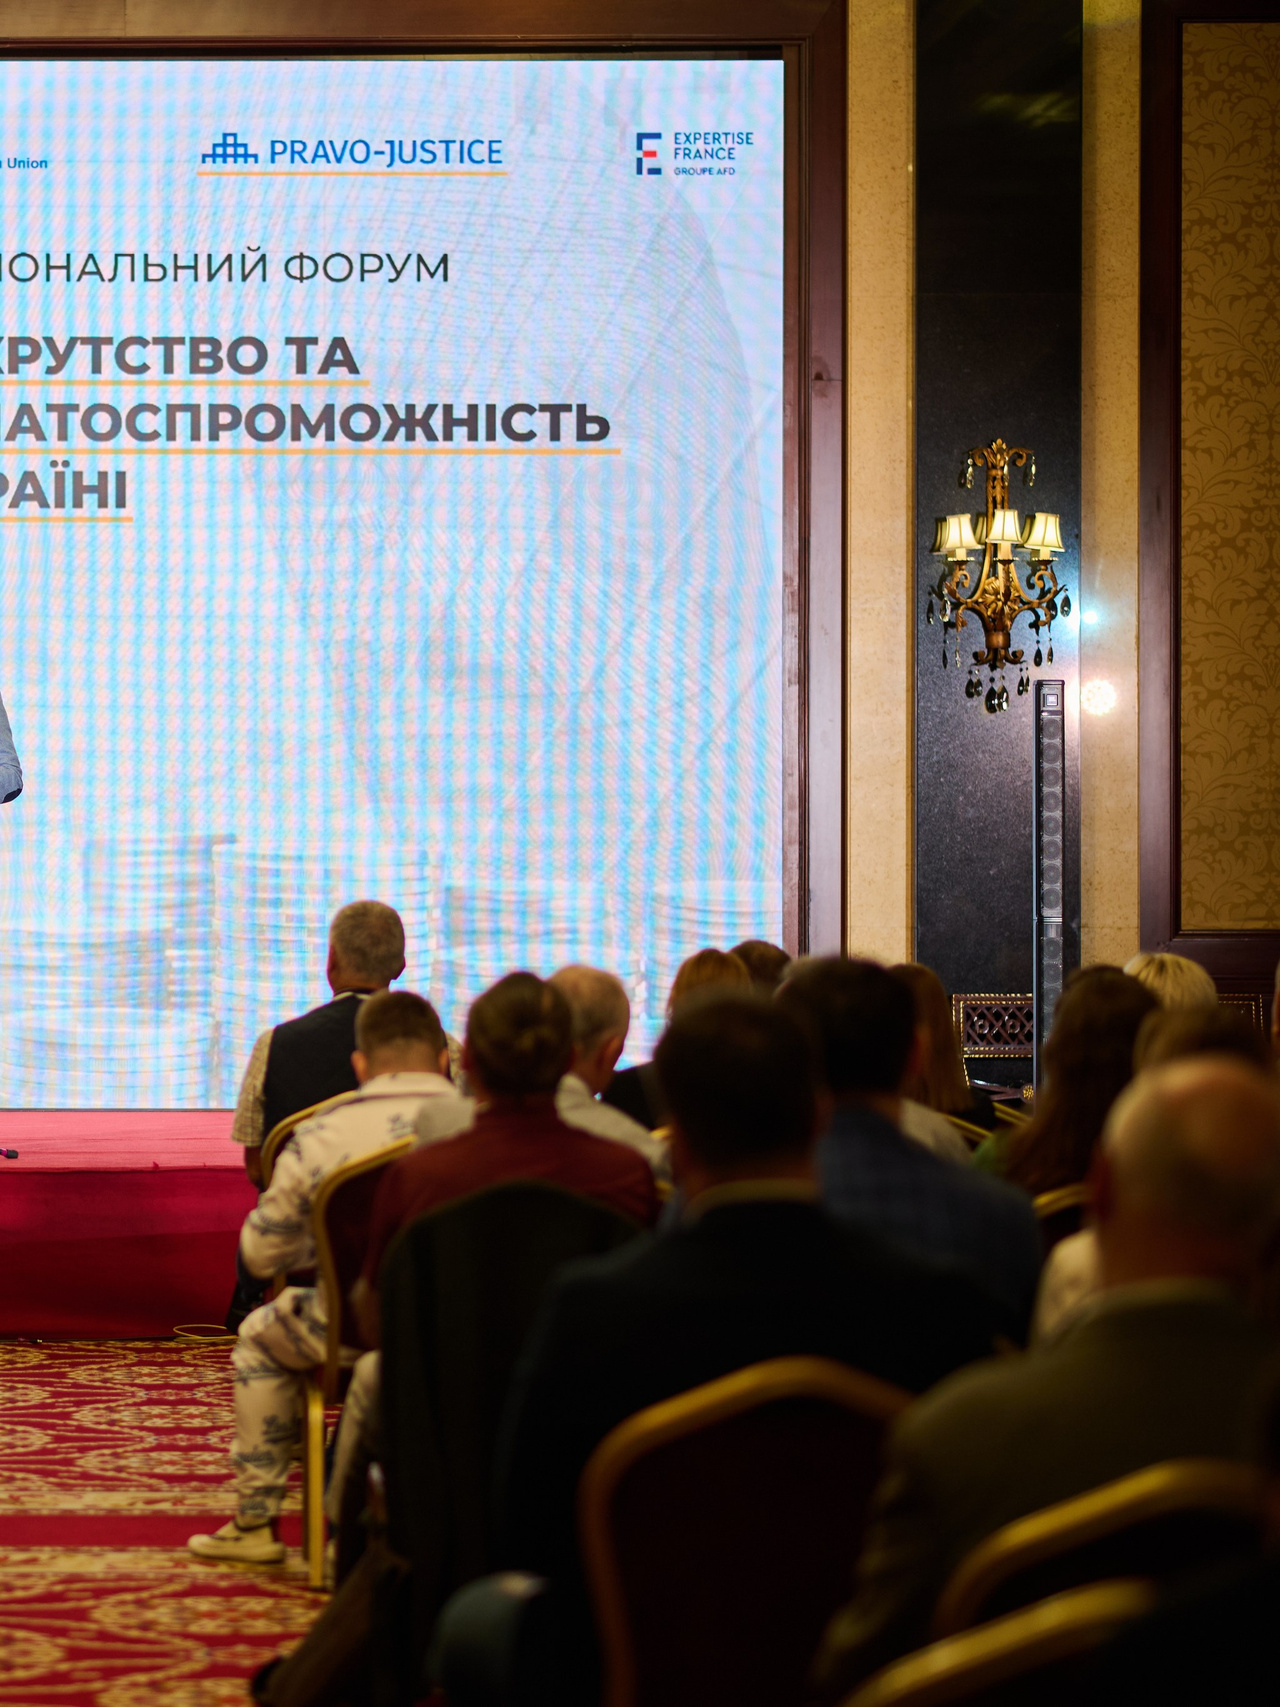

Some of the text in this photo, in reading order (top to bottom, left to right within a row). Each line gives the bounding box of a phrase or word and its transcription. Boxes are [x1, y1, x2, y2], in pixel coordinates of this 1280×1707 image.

[674, 132, 754, 145] EXPERTISE
[270, 139, 503, 168] PRAVO-JUSTICE
[674, 147, 736, 160] FRANCE
[7, 158, 48, 169] Union
[673, 167, 736, 175] GROUPE AFD
[284, 251, 449, 283] ФОРУМ
[285, 336, 361, 375] ТА
